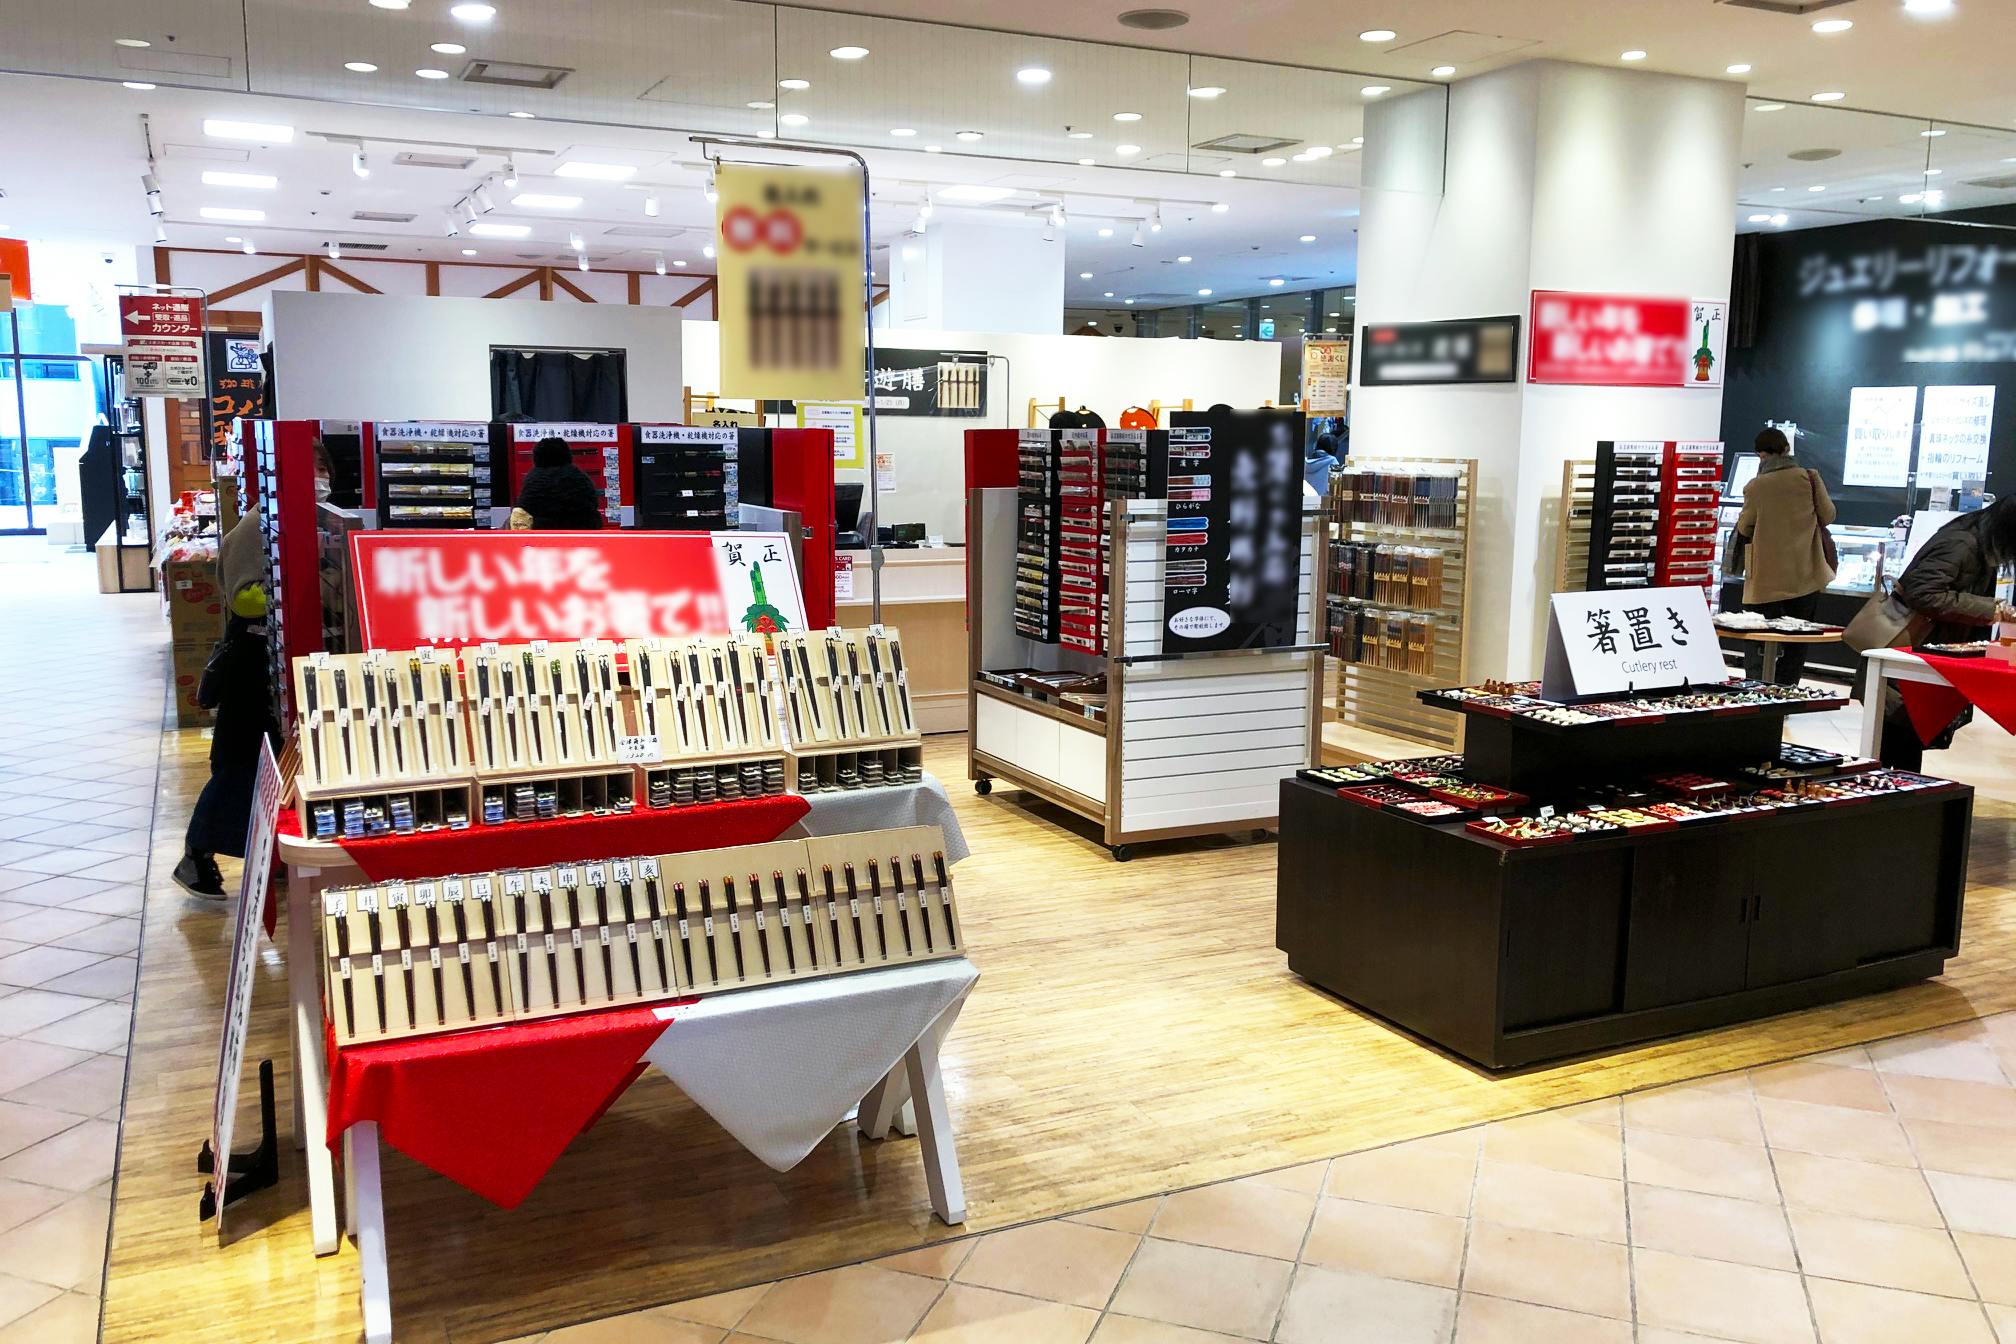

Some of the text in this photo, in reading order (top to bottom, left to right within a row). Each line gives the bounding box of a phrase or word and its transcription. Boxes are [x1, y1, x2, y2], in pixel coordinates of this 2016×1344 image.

[152, 303, 189, 312] ネット通販
[152, 324, 198, 333] カウンター
[1172, 587, 1198, 595] ローマ字
[1586, 606, 1690, 655] 箸置き
[1621, 658, 1678, 674] Cutlery rest
